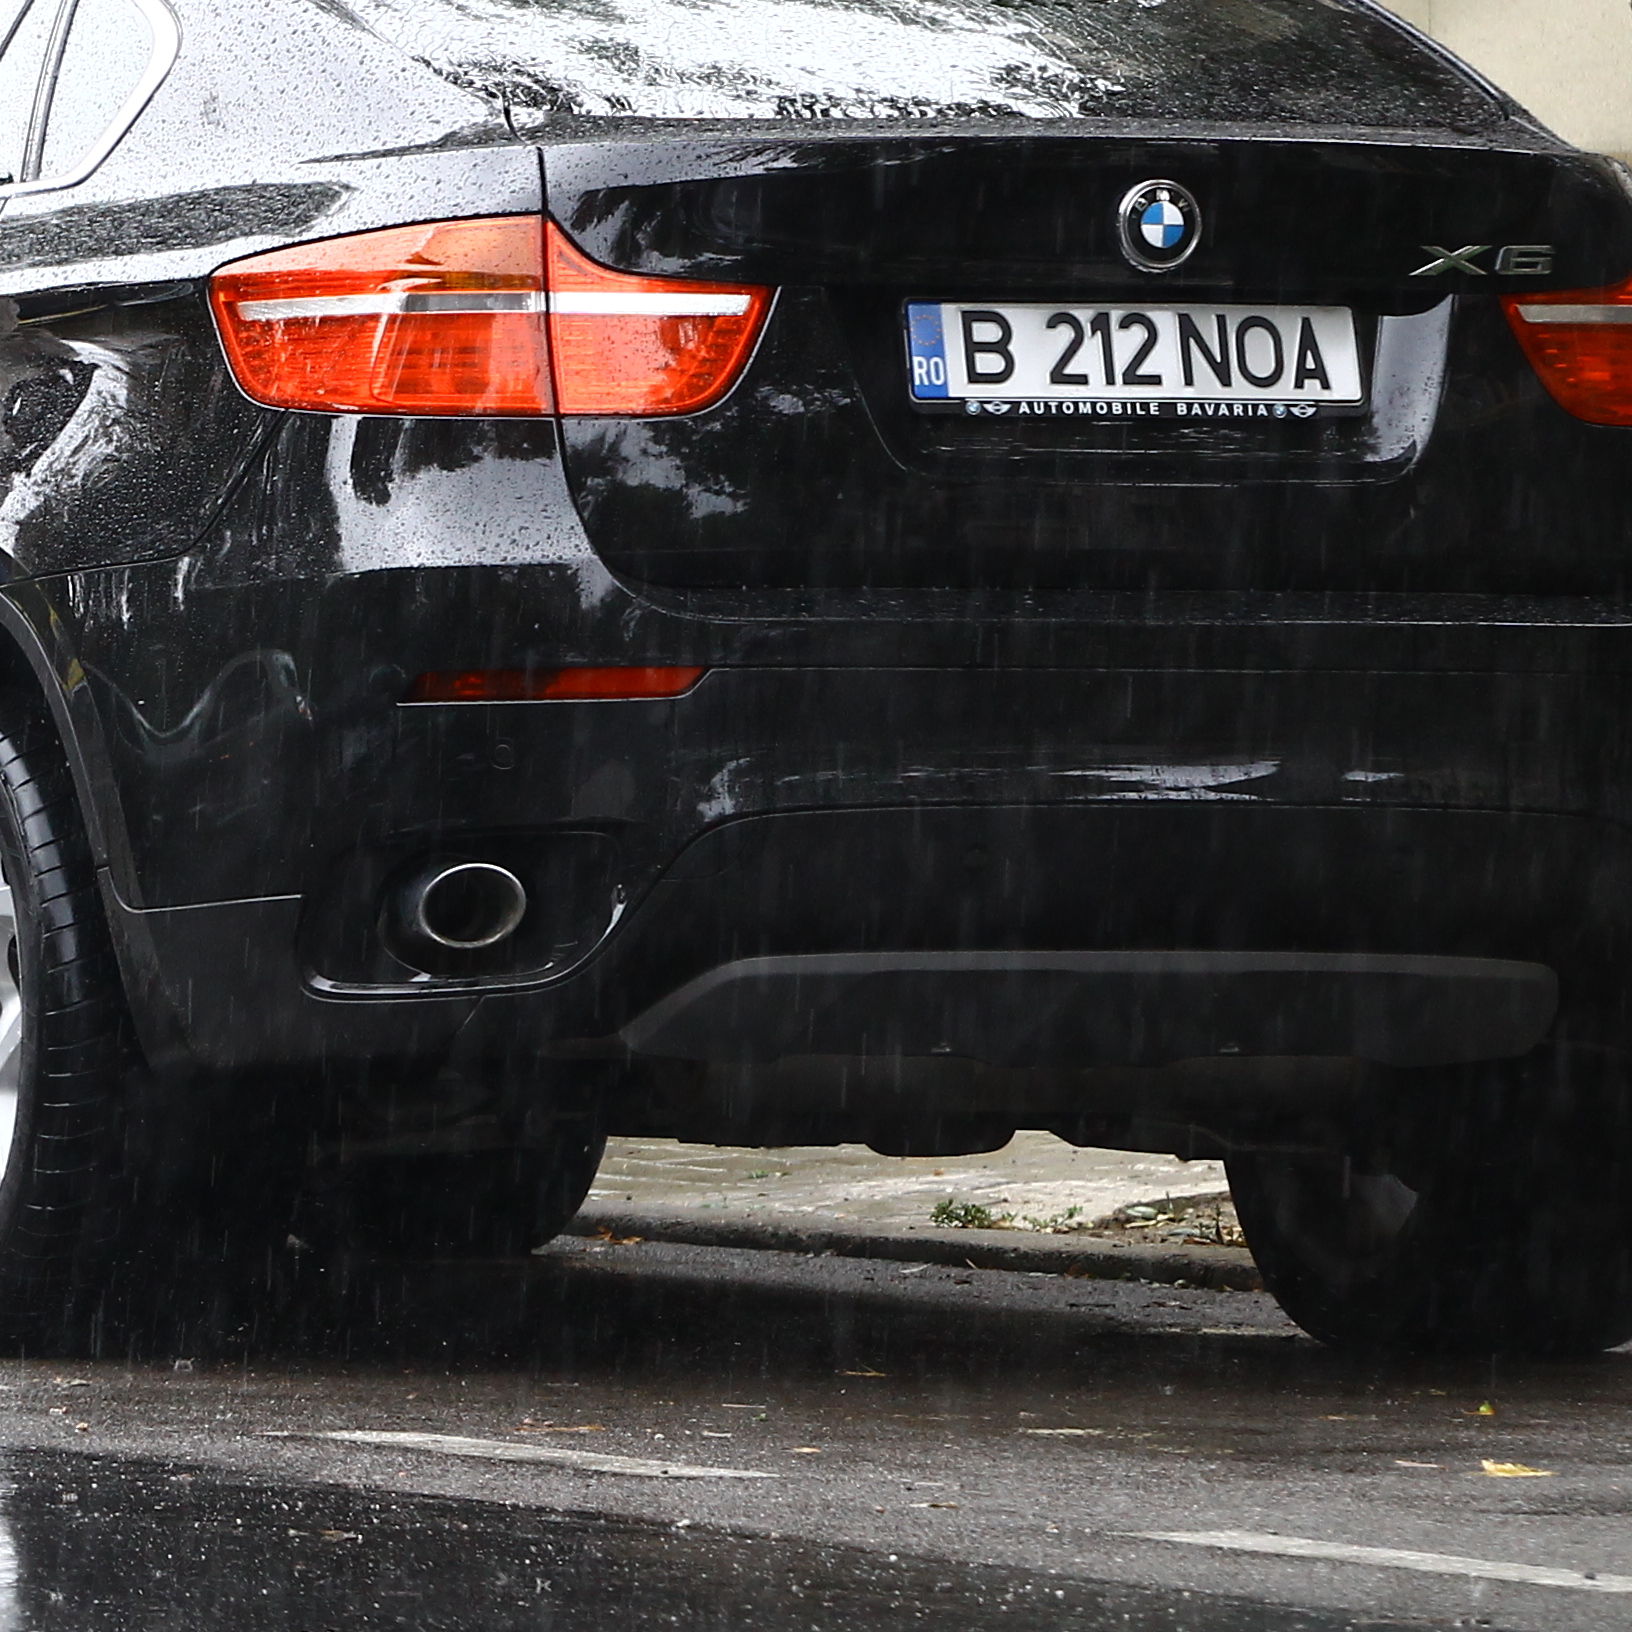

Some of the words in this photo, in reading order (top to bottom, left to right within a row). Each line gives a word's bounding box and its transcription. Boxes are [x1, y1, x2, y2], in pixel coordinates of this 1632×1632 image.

[1409, 245, 1556, 276] X6
[960, 310, 1015, 385] B
[1045, 312, 1163, 386] 212
[1179, 312, 1330, 391] NOA
[913, 355, 945, 386] RO
[1018, 400, 1160, 416] AUTOMOBILE
[1177, 402, 1269, 417] BAVARIA
